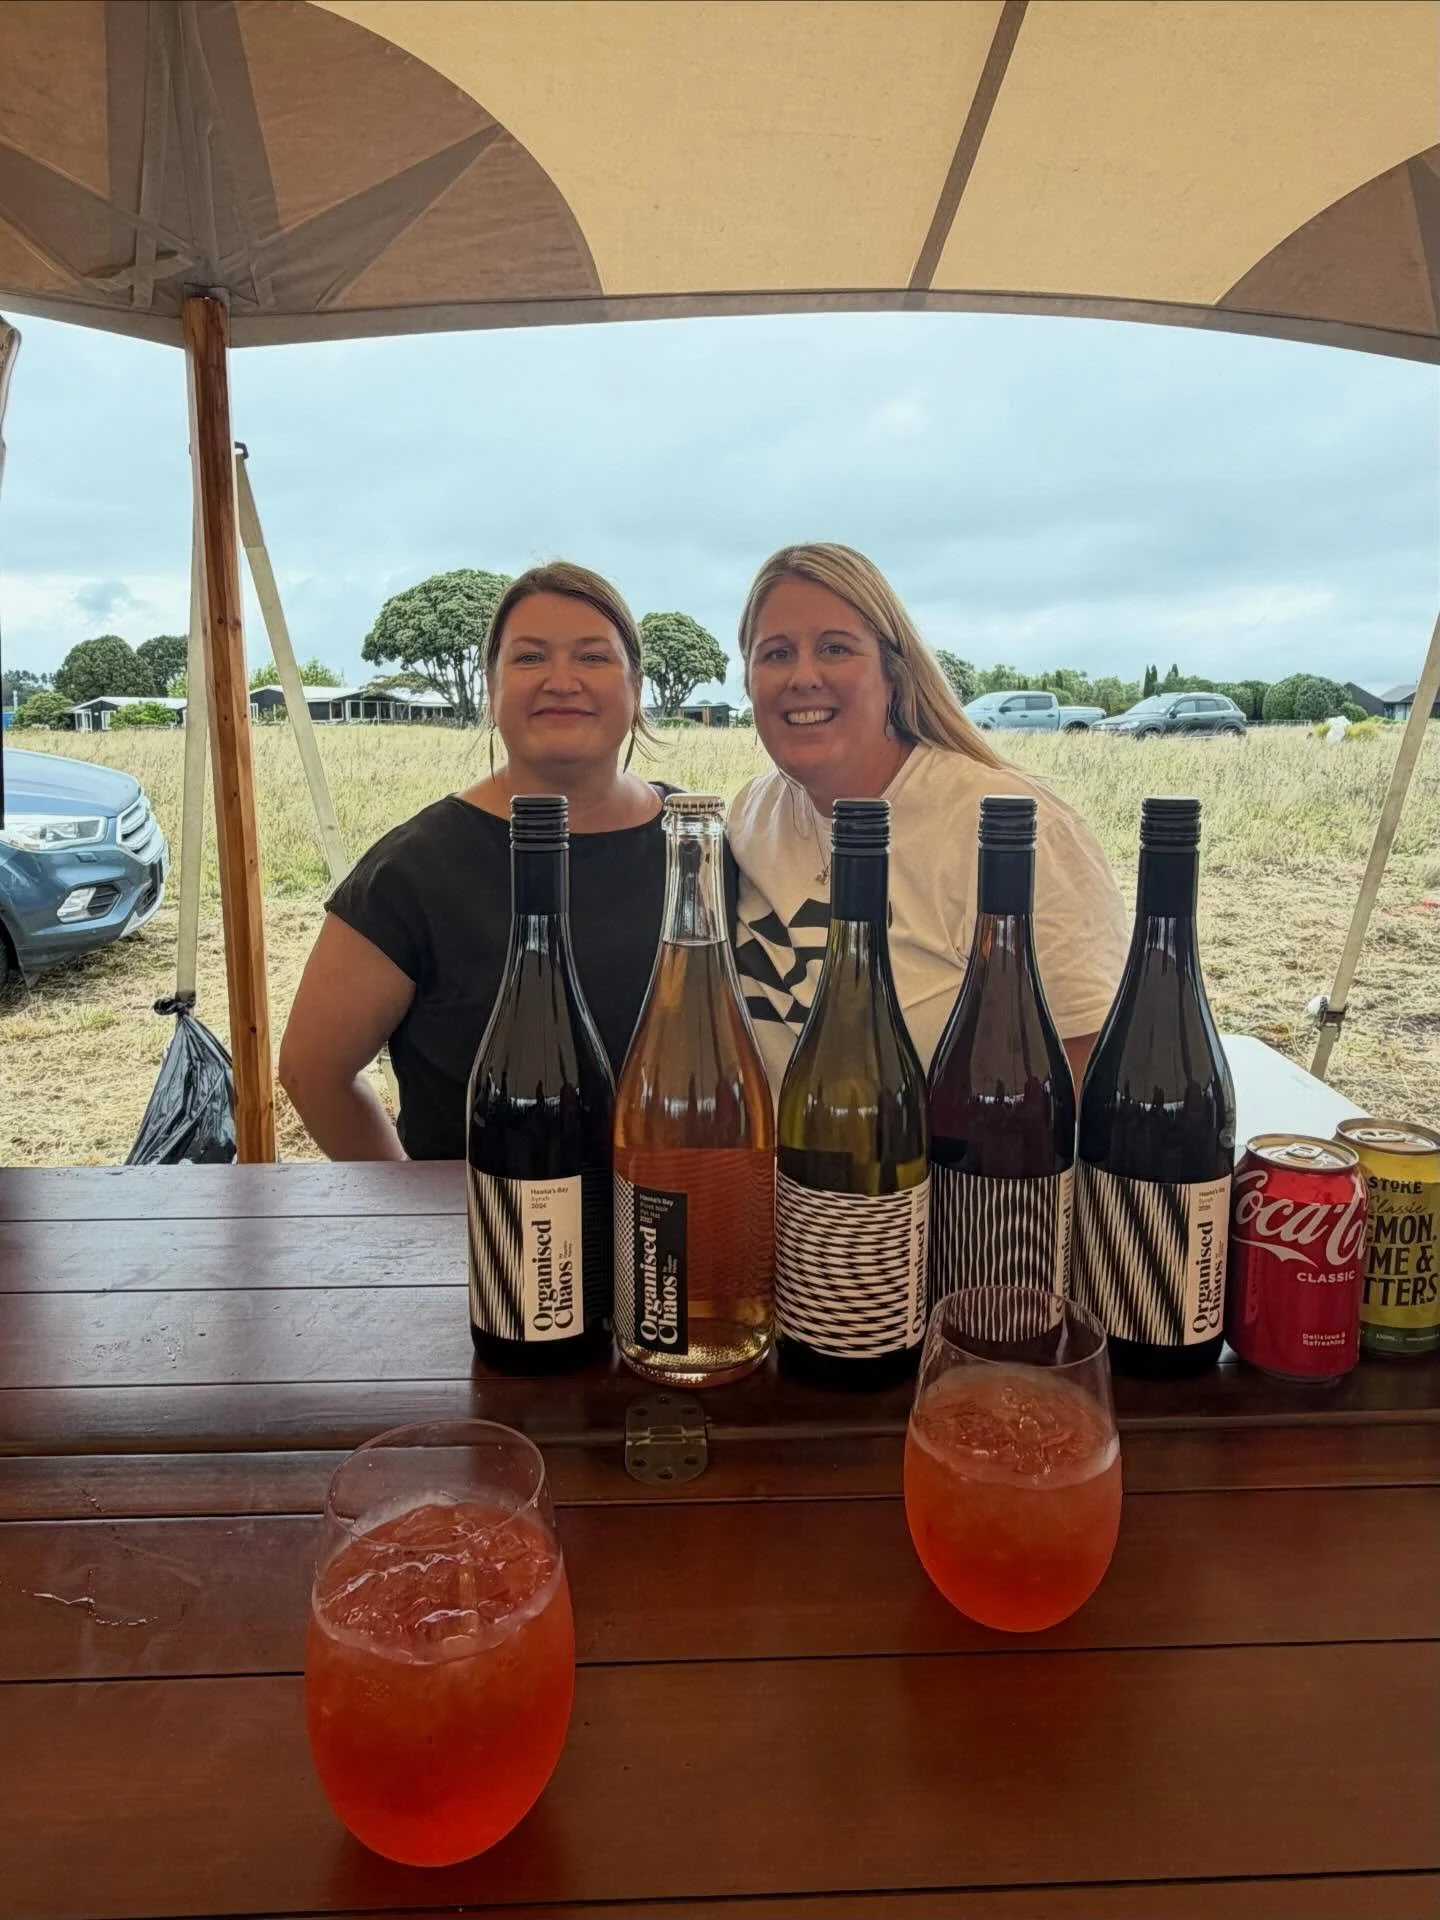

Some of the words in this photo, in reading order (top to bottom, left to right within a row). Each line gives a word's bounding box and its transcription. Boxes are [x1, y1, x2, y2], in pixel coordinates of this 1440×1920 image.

[557, 1186, 569, 1194] Bay
[662, 1197, 674, 1208] Bay
[1368, 1176, 1424, 1194] STOKE
[531, 1219, 558, 1332] Organised
[639, 1225, 663, 1341] Organised
[1192, 1220, 1214, 1334] Organised
[1296, 1270, 1356, 1283] CLASSIC
[1415, 1244, 1435, 1274] &
[553, 1260, 574, 1329] Chaos
[657, 1275, 679, 1345] Chaos
[1207, 1259, 1224, 1329] Chaos
